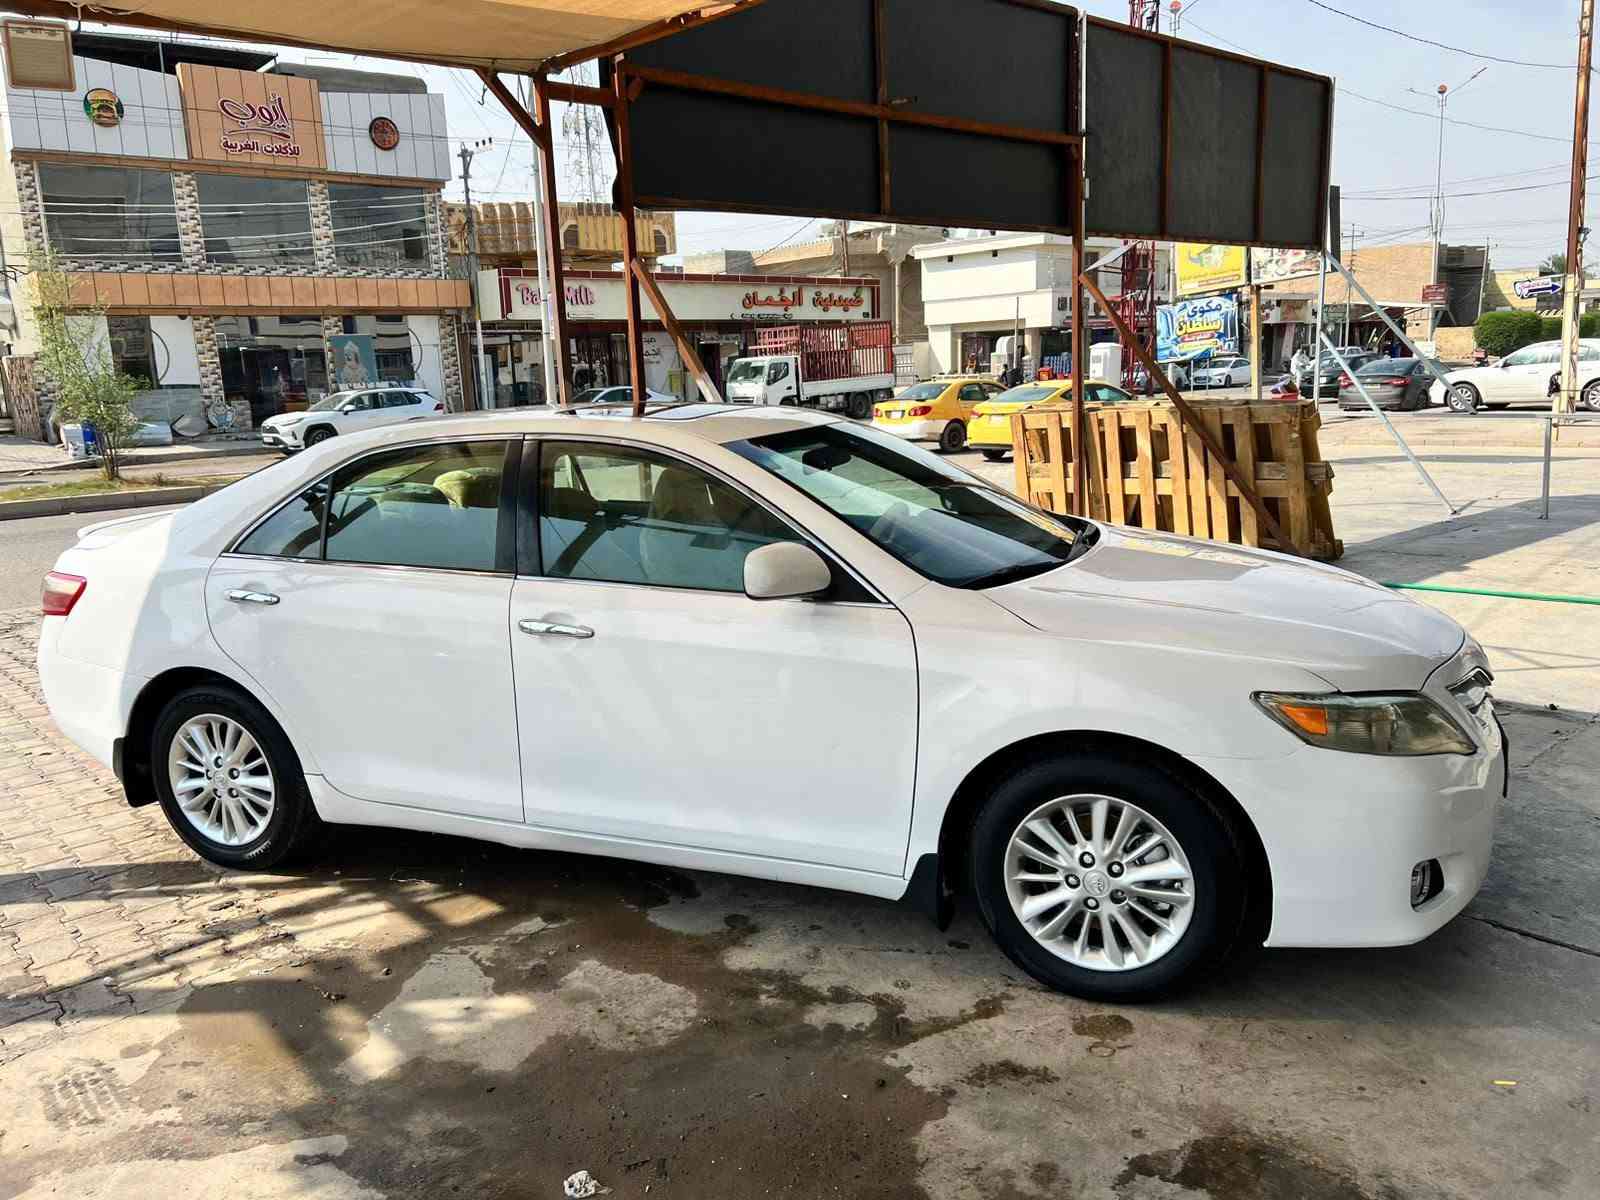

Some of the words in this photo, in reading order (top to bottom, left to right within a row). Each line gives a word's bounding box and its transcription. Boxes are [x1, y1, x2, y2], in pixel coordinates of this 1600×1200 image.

[218, 93, 290, 129] أيوب
[222, 137, 260, 153] الغربية
[263, 142, 300, 156] للأكلات
[565, 286, 595, 306] Milk
[812, 287, 865, 312] صيدلية
